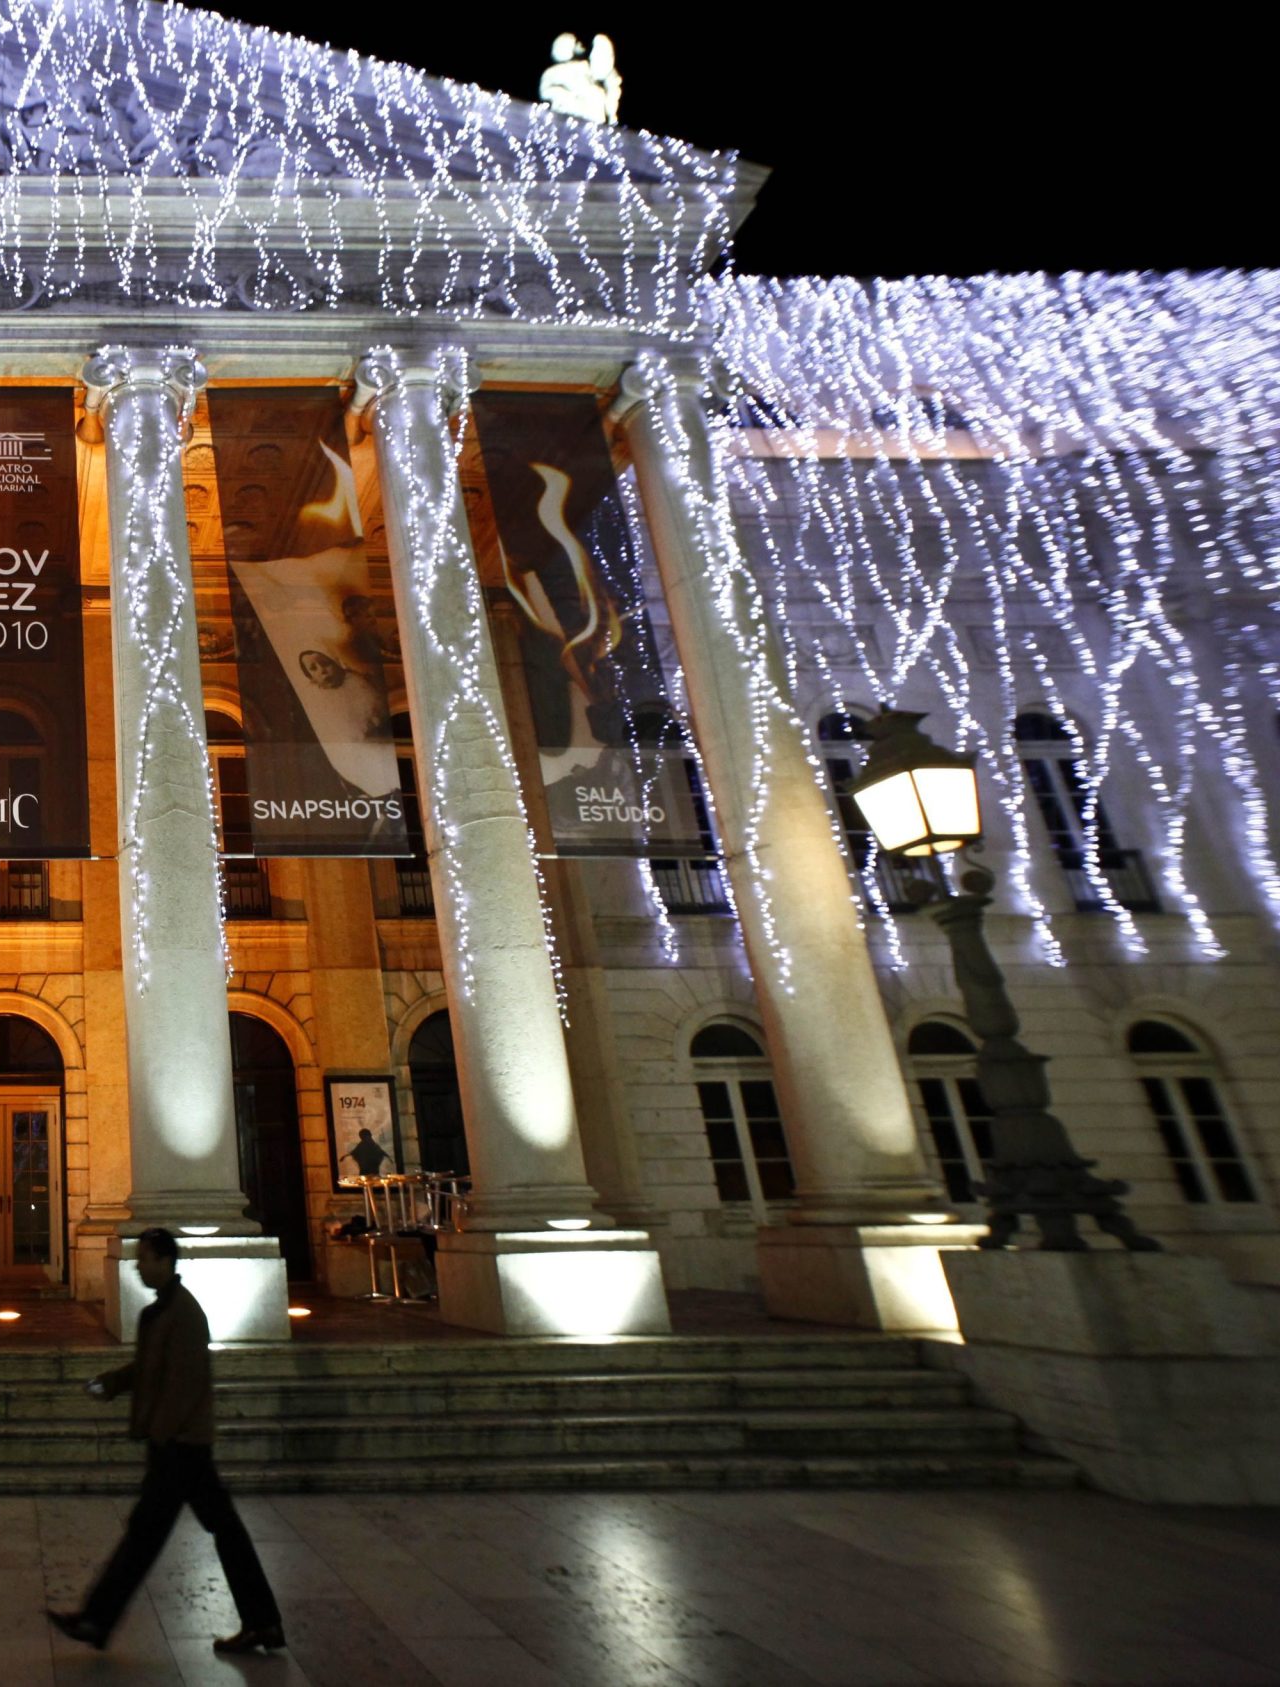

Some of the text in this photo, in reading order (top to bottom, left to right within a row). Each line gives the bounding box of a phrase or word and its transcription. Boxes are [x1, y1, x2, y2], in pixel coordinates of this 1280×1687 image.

[27, 485, 34, 493] II
[575, 786, 625, 803] SALA
[253, 799, 402, 820] SNAPSHOTS
[339, 1096, 366, 1110] 1974
